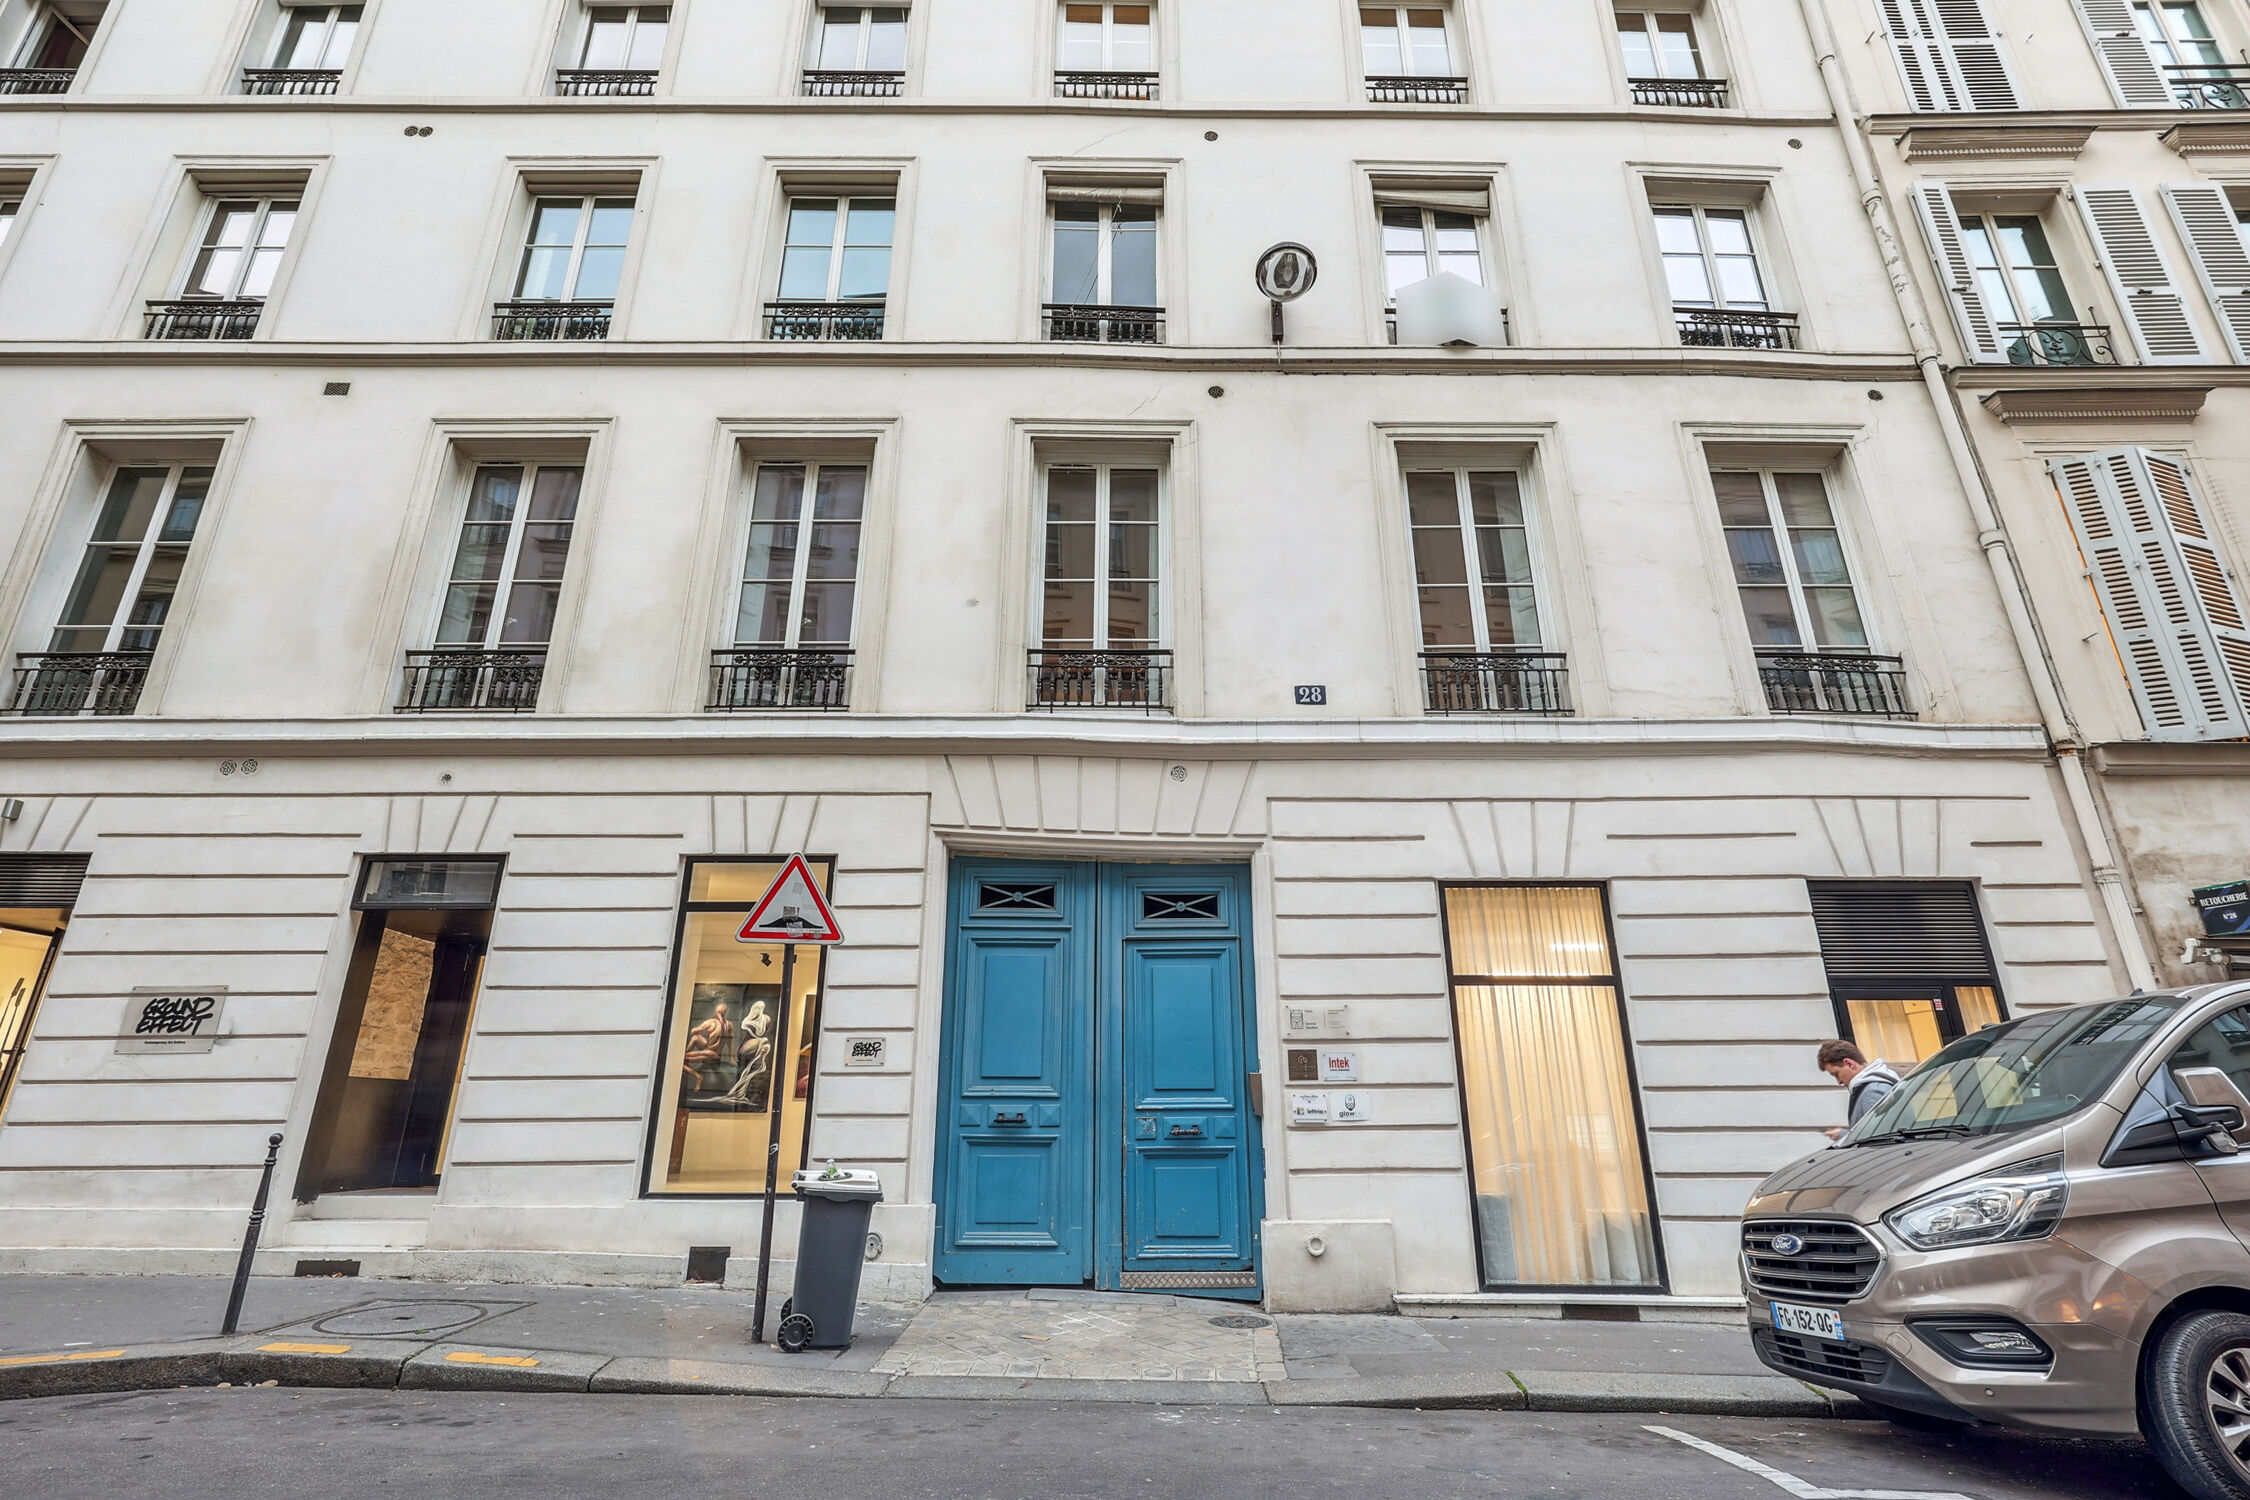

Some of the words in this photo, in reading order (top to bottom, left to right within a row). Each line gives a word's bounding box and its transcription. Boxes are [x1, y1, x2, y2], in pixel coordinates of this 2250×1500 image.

[1299, 687, 1322, 703] 28
[2200, 892, 2249, 907] RETOUCHERIE
[142, 997, 215, 1017] GROUND
[135, 1012, 214, 1036] EFFECT
[852, 1048, 882, 1058] EFFECT
[1328, 1057, 1350, 1068] Intek
[1775, 1236, 1792, 1249] Ford
